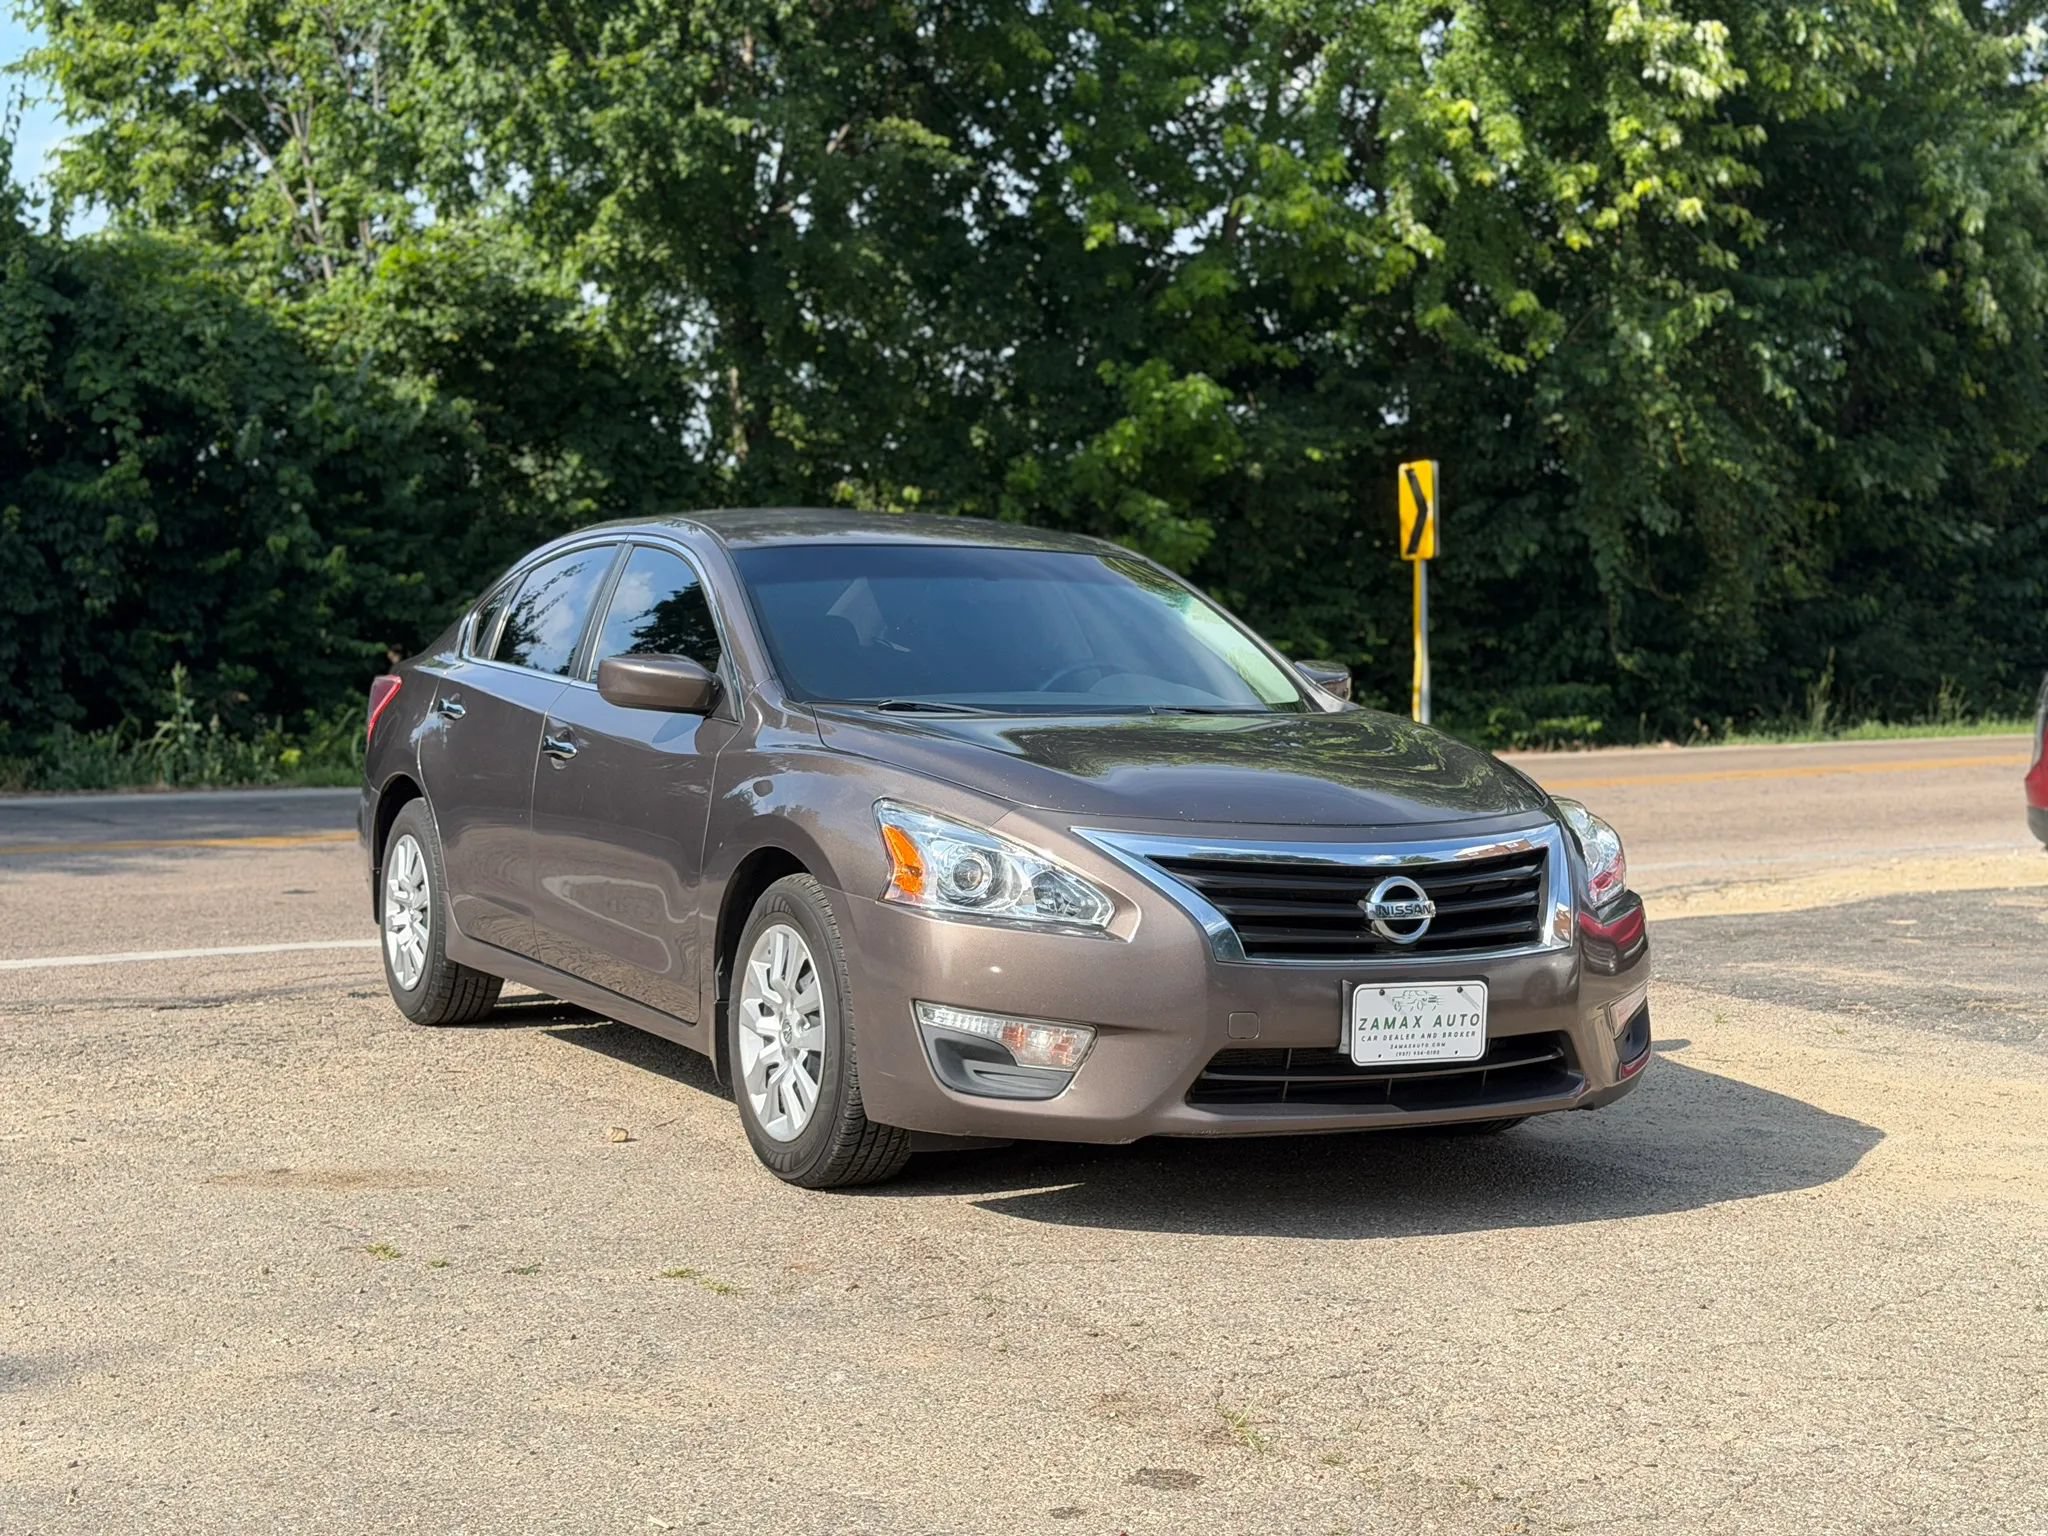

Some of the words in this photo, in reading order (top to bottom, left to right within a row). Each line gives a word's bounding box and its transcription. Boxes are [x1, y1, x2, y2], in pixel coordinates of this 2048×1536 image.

[1379, 903, 1431, 916] NISSAN
[1358, 1015, 1423, 1031] ZAMAX
[1432, 1013, 1480, 1028] AUTO
[1382, 1033, 1416, 1041] DEALER
[1442, 1030, 1476, 1038] BROKER
